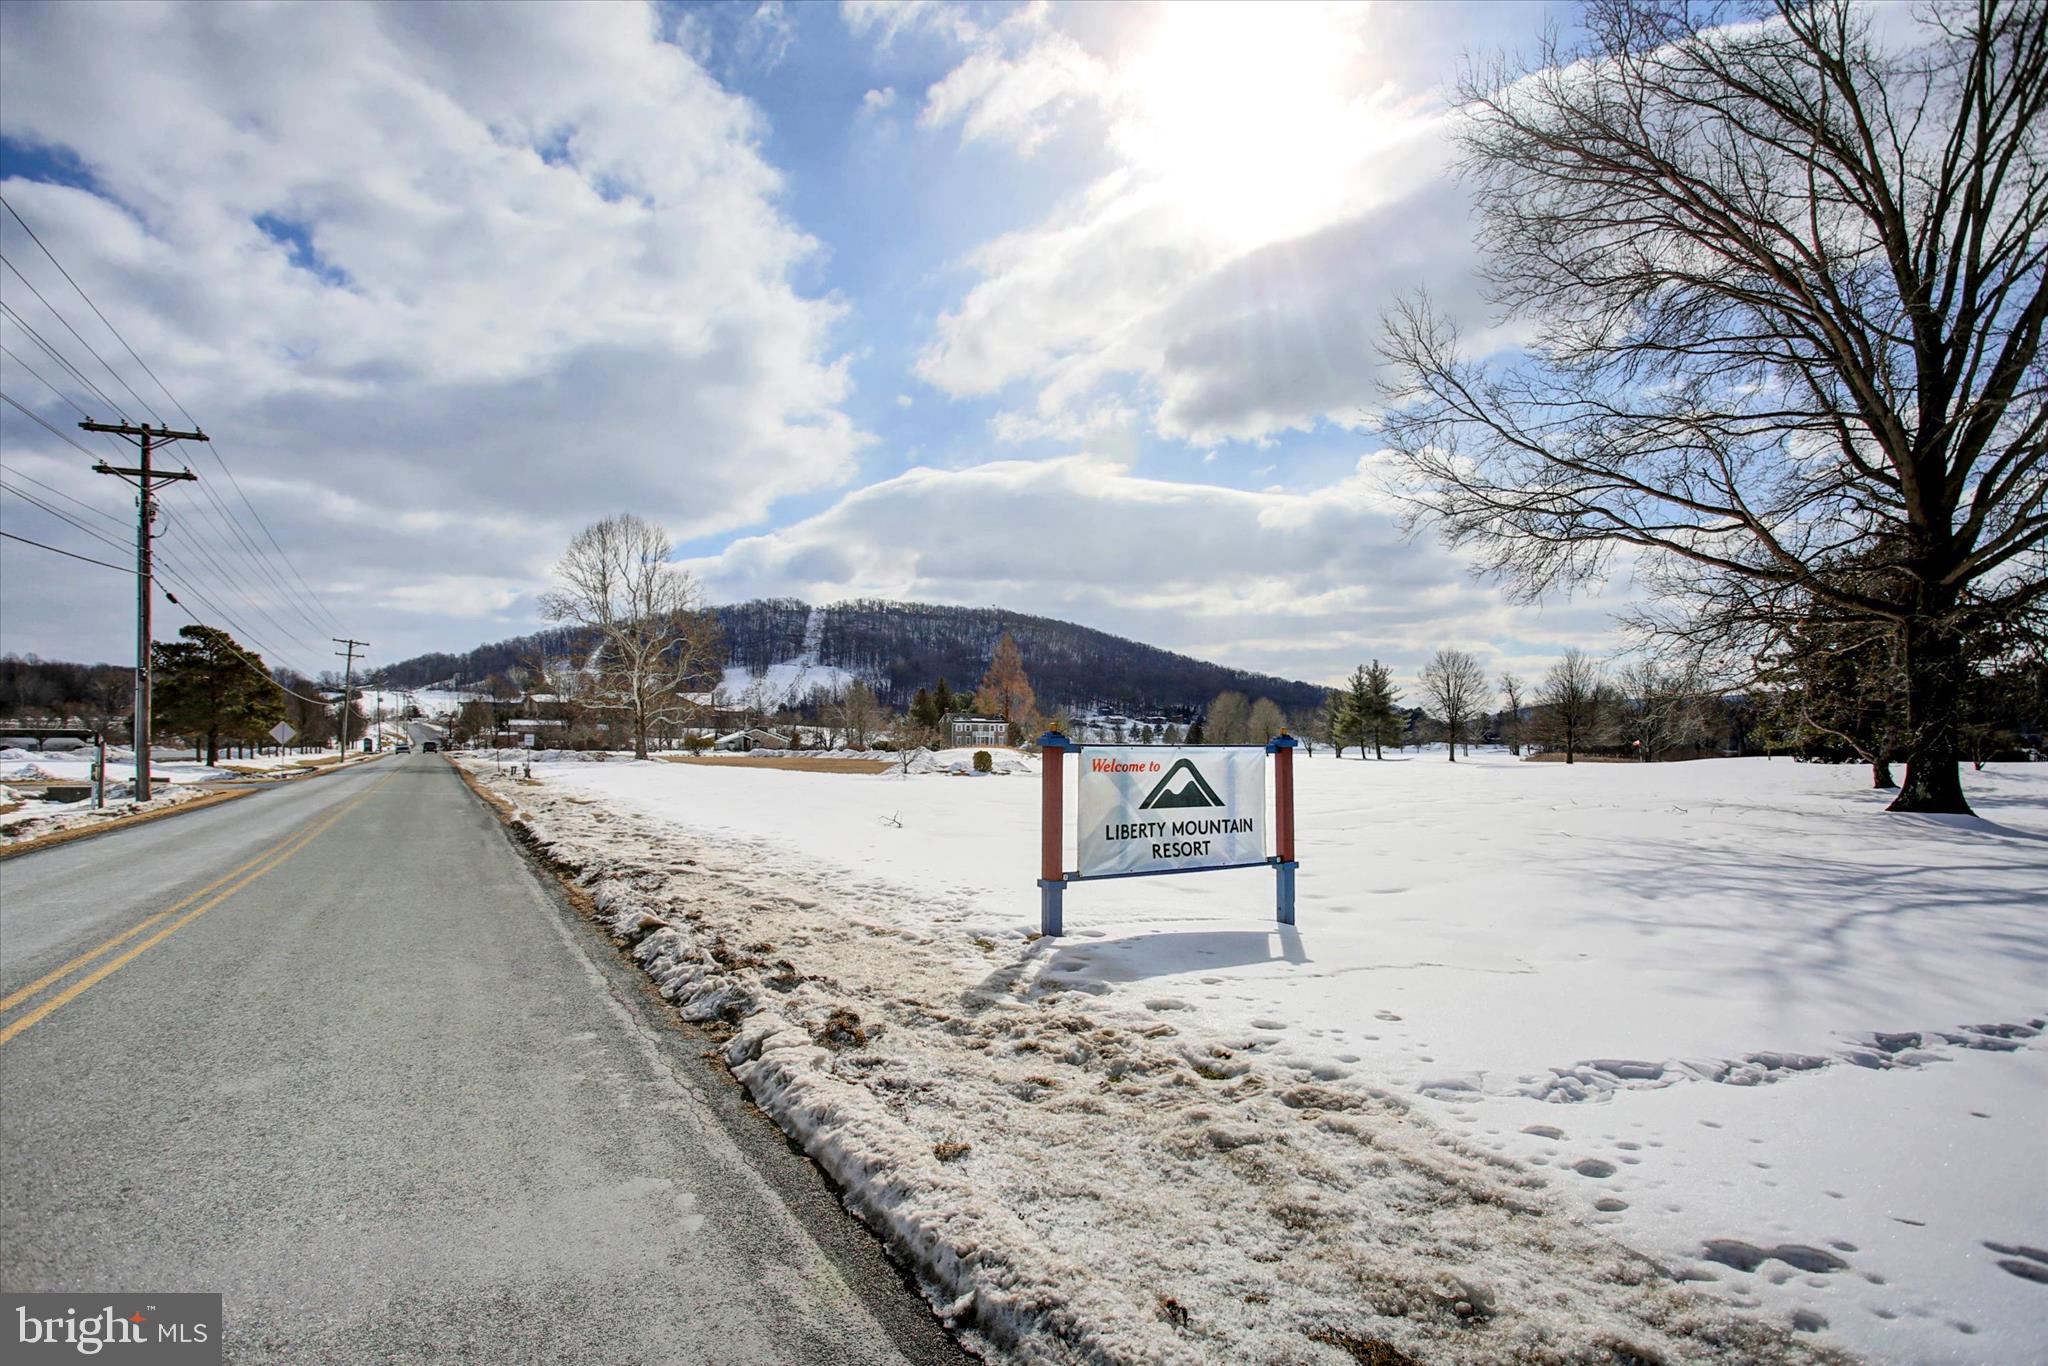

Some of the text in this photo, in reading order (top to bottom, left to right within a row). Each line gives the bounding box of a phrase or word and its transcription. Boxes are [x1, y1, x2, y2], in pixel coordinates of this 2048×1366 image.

[1092, 758, 1161, 773] Welcome to
[1105, 818, 1253, 841] LIBERTY MOUNTAIN
[1152, 841, 1211, 860] RESORT
